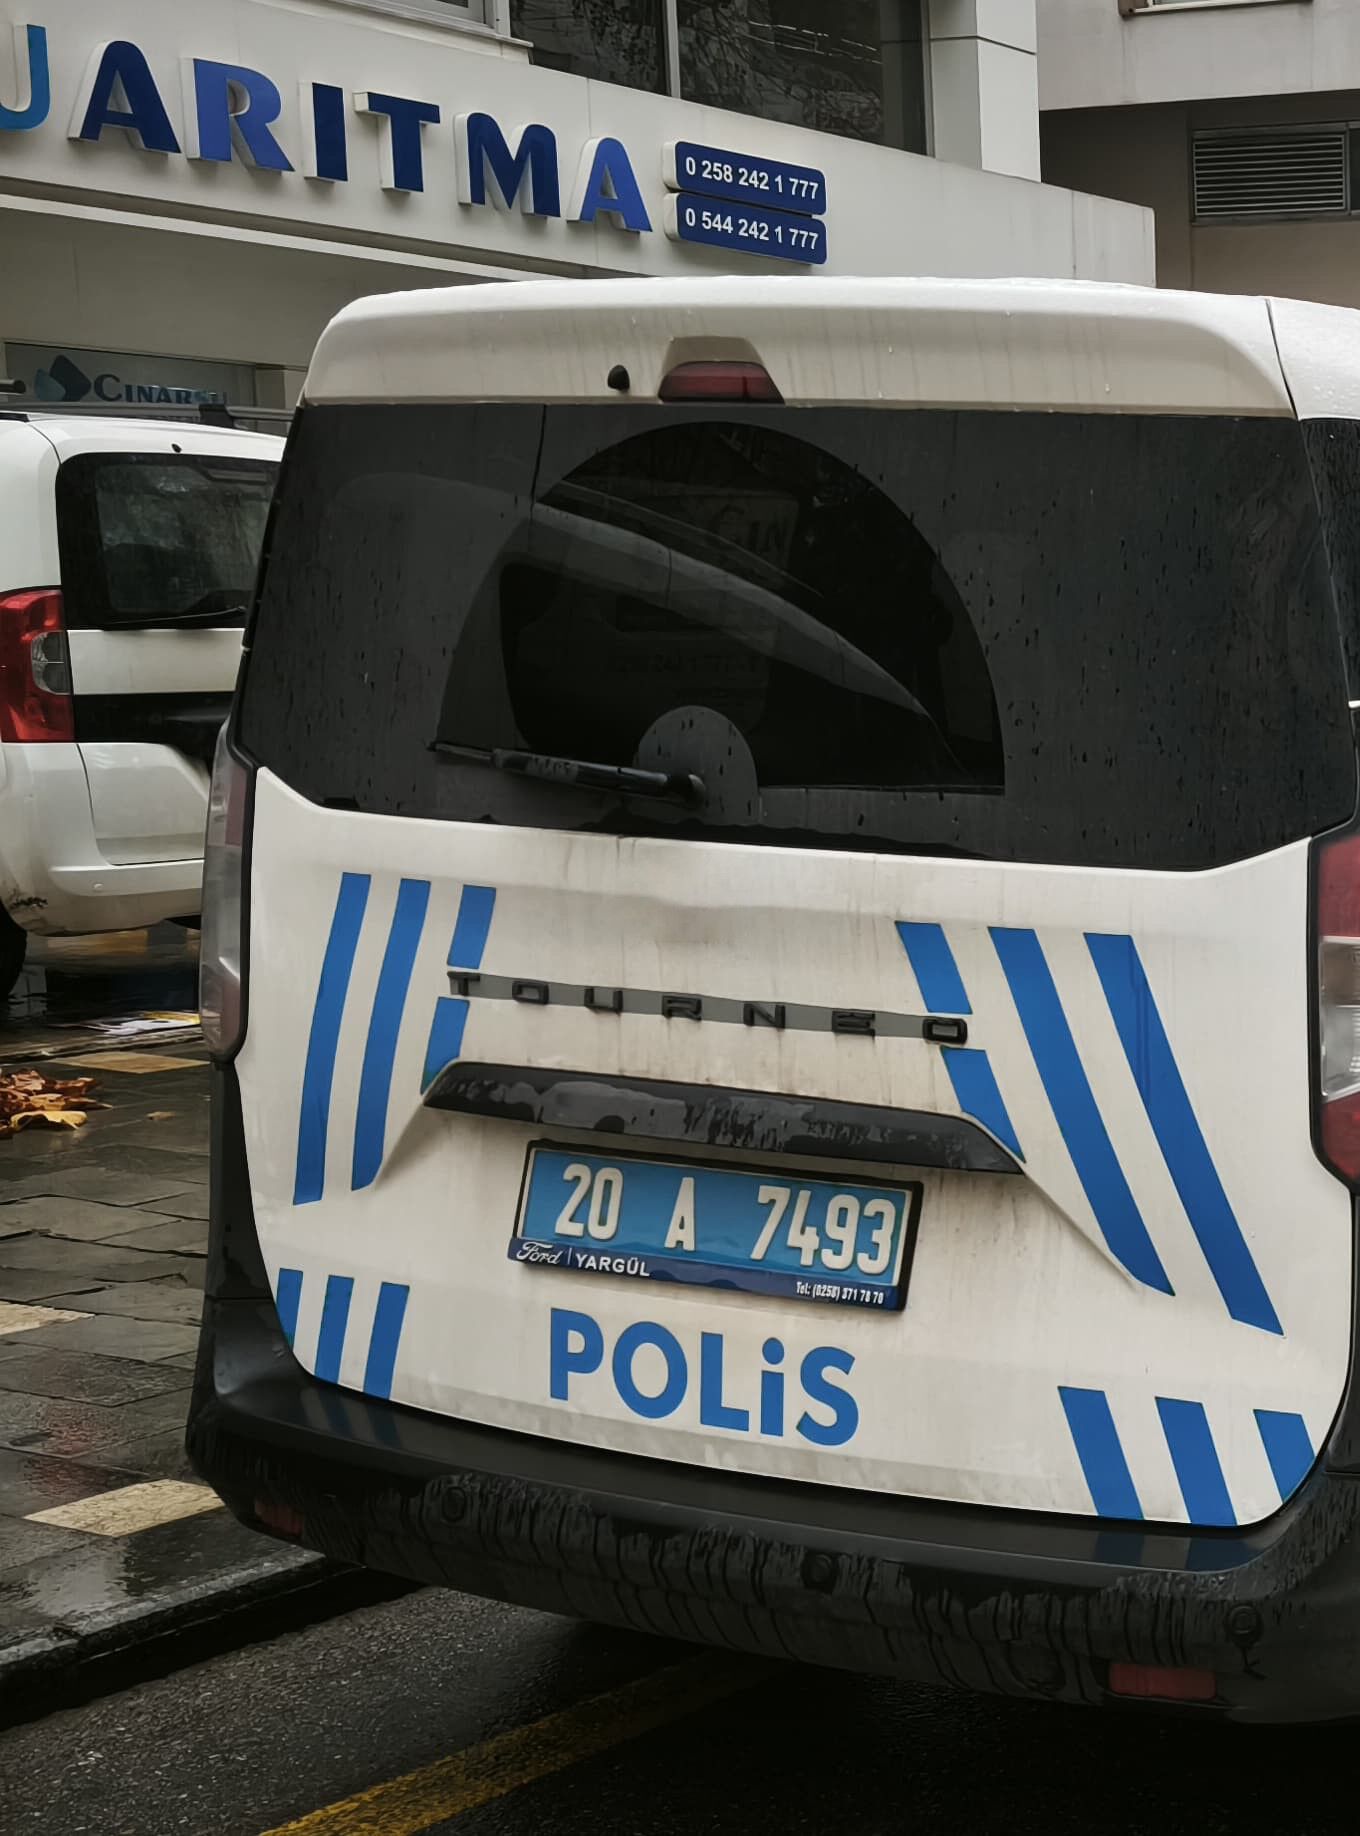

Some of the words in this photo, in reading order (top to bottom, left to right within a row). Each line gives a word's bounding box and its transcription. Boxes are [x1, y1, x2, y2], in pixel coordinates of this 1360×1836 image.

[68, 40, 654, 233] ARITMA
[685, 156, 696, 176] 0
[701, 160, 733, 183] 258
[738, 168, 770, 191] 242
[774, 175, 783, 193] 1
[789, 178, 819, 199] 777
[685, 208, 696, 227] 0
[701, 211, 734, 234] 544
[738, 218, 770, 241] 242
[774, 226, 783, 244] 1
[789, 228, 819, 250] 777
[447, 971, 968, 1045] TOURNEO
[554, 1163, 624, 1241] 20
[664, 1176, 696, 1251] A
[750, 1185, 896, 1275] 7493
[516, 1240, 561, 1266] Ford
[575, 1254, 650, 1278] YARGÜL
